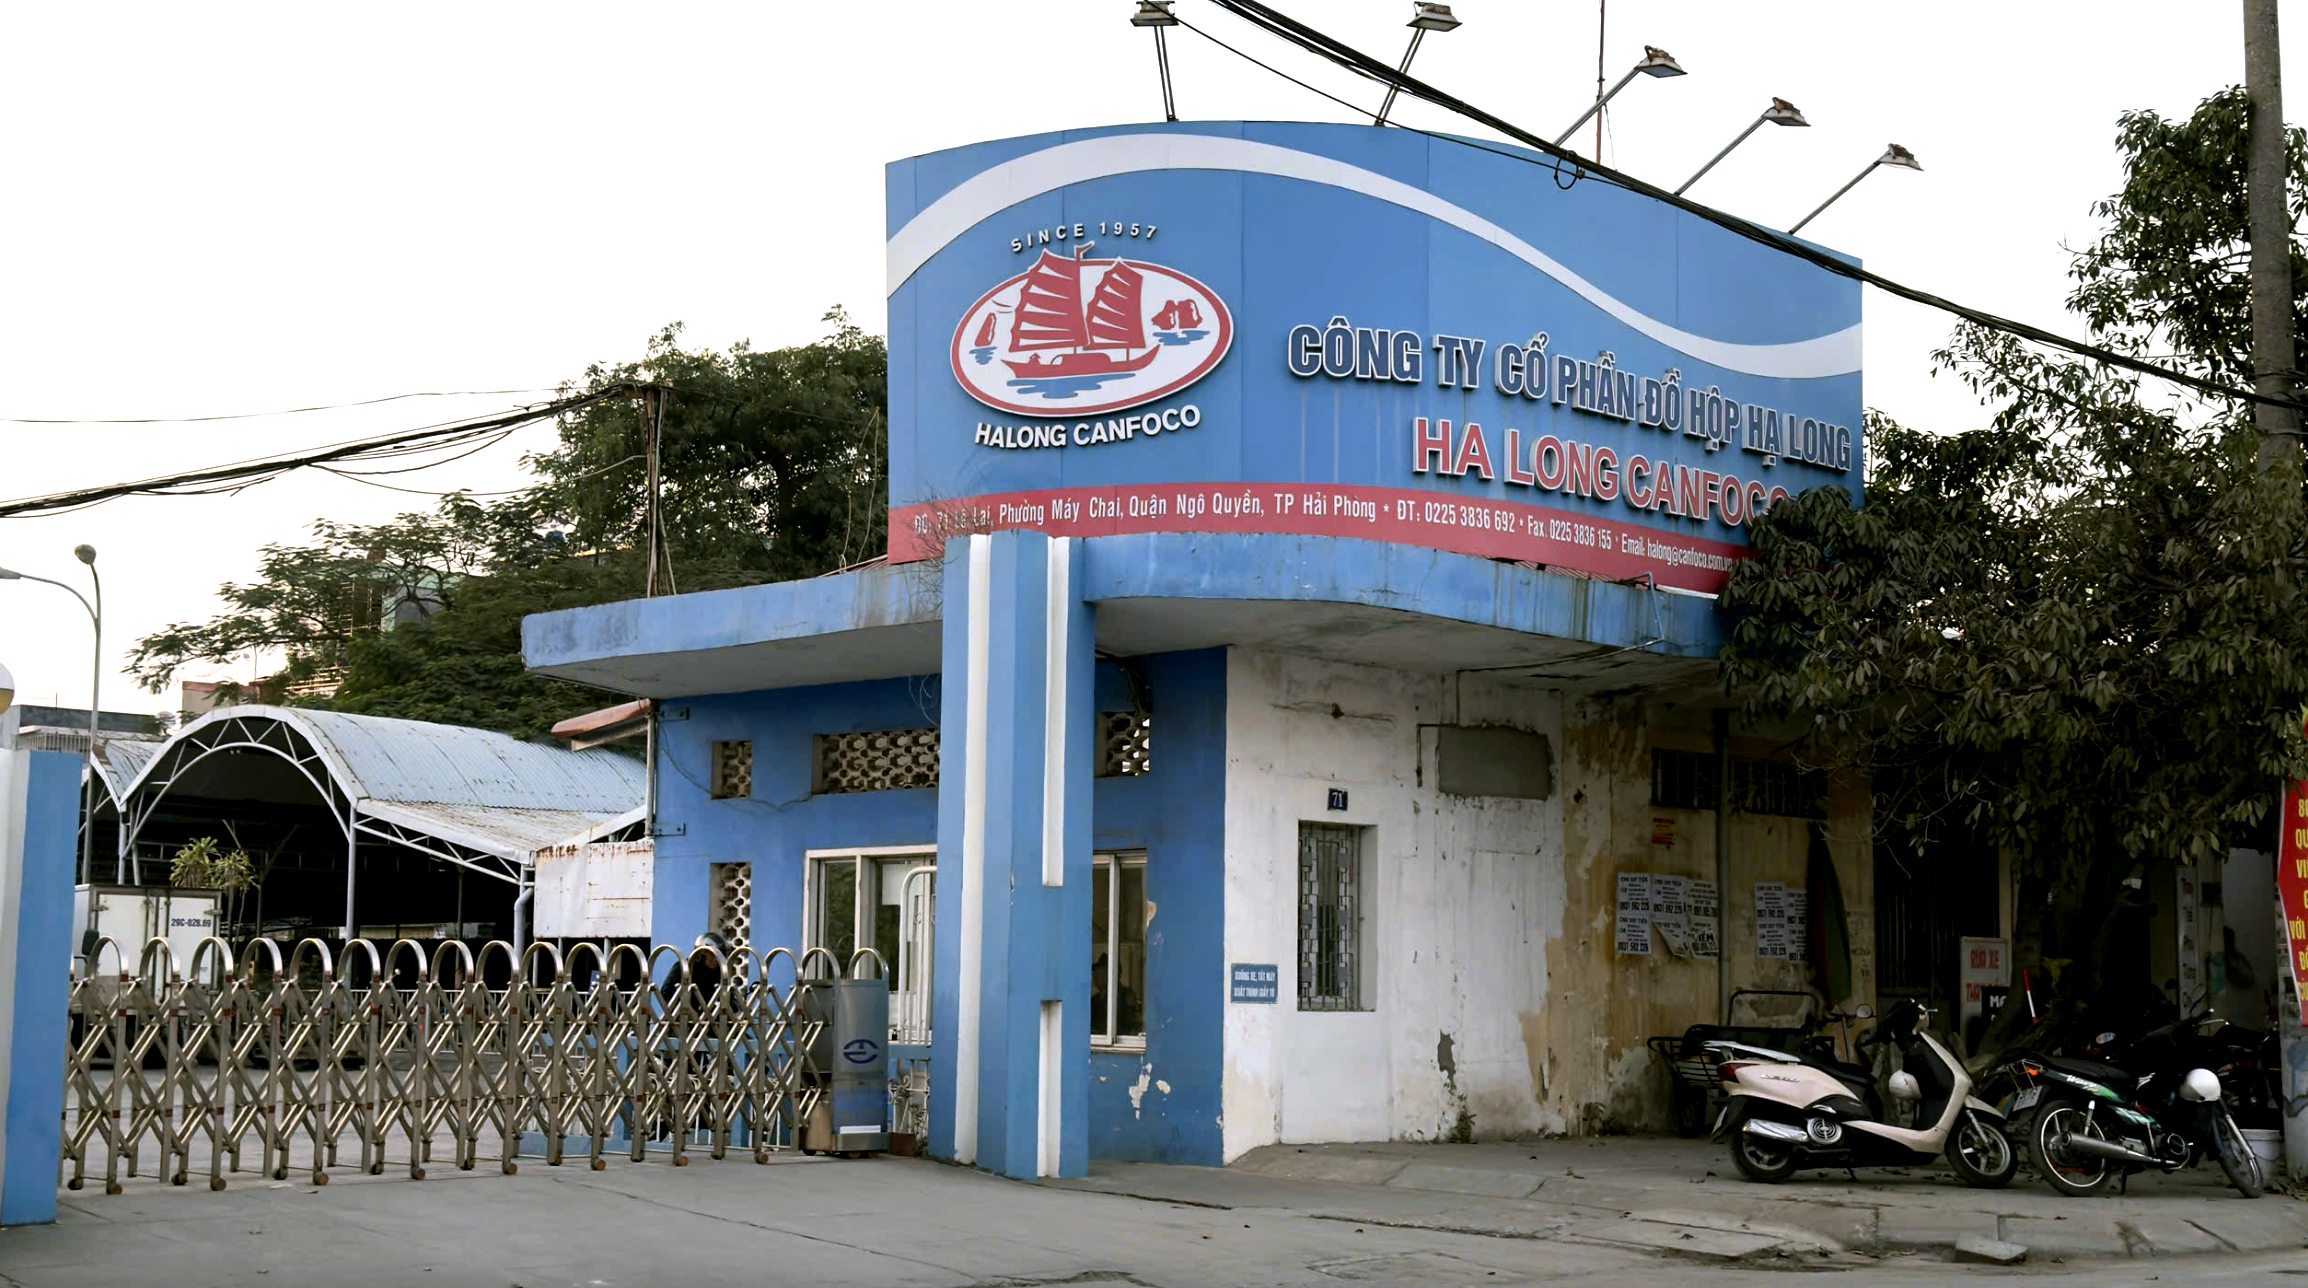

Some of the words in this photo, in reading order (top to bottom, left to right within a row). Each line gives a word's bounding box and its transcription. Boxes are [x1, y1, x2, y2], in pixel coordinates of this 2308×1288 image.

[1011, 223, 1084, 253] SINCE
[1100, 222, 1157, 239] 1957
[1288, 316, 1422, 384] CÔNG
[1433, 334, 1486, 389] TY
[1495, 331, 1549, 400] CỔ
[1552, 350, 1636, 421] PHẦN
[1639, 368, 1682, 431] ĐỒ
[1684, 385, 1740, 451] HỘP
[1741, 404, 1781, 466] HẠ
[1782, 413, 1851, 472] LONG
[975, 422, 1066, 448] HALONG
[1073, 404, 1201, 446] CANFOCO
[1413, 417, 1494, 479] HA
[1504, 429, 1619, 501] LONG
[999, 499, 1044, 525] Phường
[1052, 497, 1080, 523] Máy
[1090, 497, 1123, 519] Chai,
[1129, 494, 1166, 518] Quận
[1177, 493, 1205, 518] Ngô
[1213, 489, 1264, 517] Quyền,
[1274, 493, 1294, 515] TP
[1303, 492, 1327, 516] Hải
[1333, 495, 1376, 522] Phòng
[1397, 500, 1420, 522] ĐT:
[1425, 501, 1456, 525] 0225
[1460, 506, 1490, 531] 3836
[1494, 510, 1515, 533] 692
[1549, 519, 1572, 542] 0225
[1573, 523, 1595, 547] 3836
[1597, 527, 1612, 550] 155
[1331, 791, 1343, 807] 71
